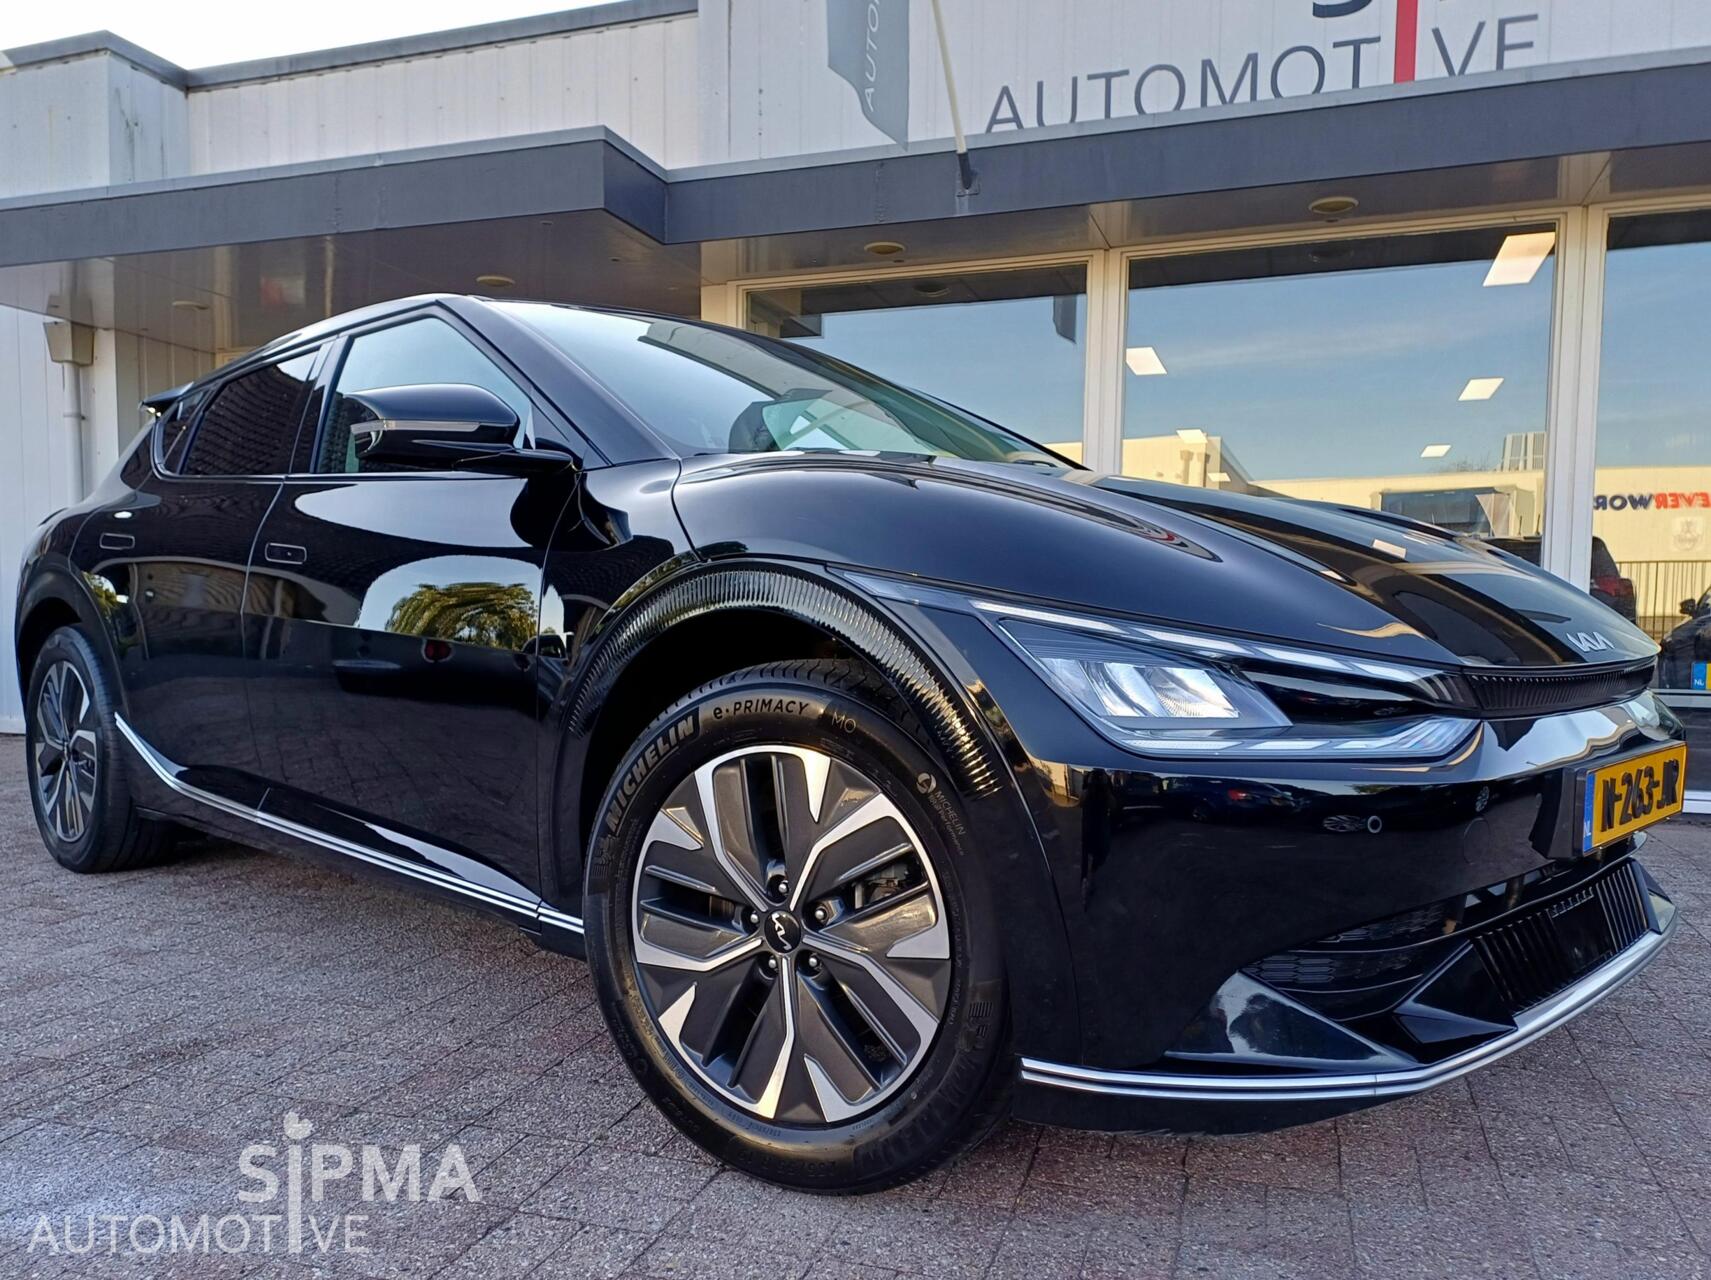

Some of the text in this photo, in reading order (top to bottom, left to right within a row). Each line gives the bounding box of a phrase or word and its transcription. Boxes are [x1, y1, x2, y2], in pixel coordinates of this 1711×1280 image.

[985, 14, 1539, 133] AUTOMOTIVE
[605, 715, 695, 832] MICHELIN
[832, 711, 857, 733] MO
